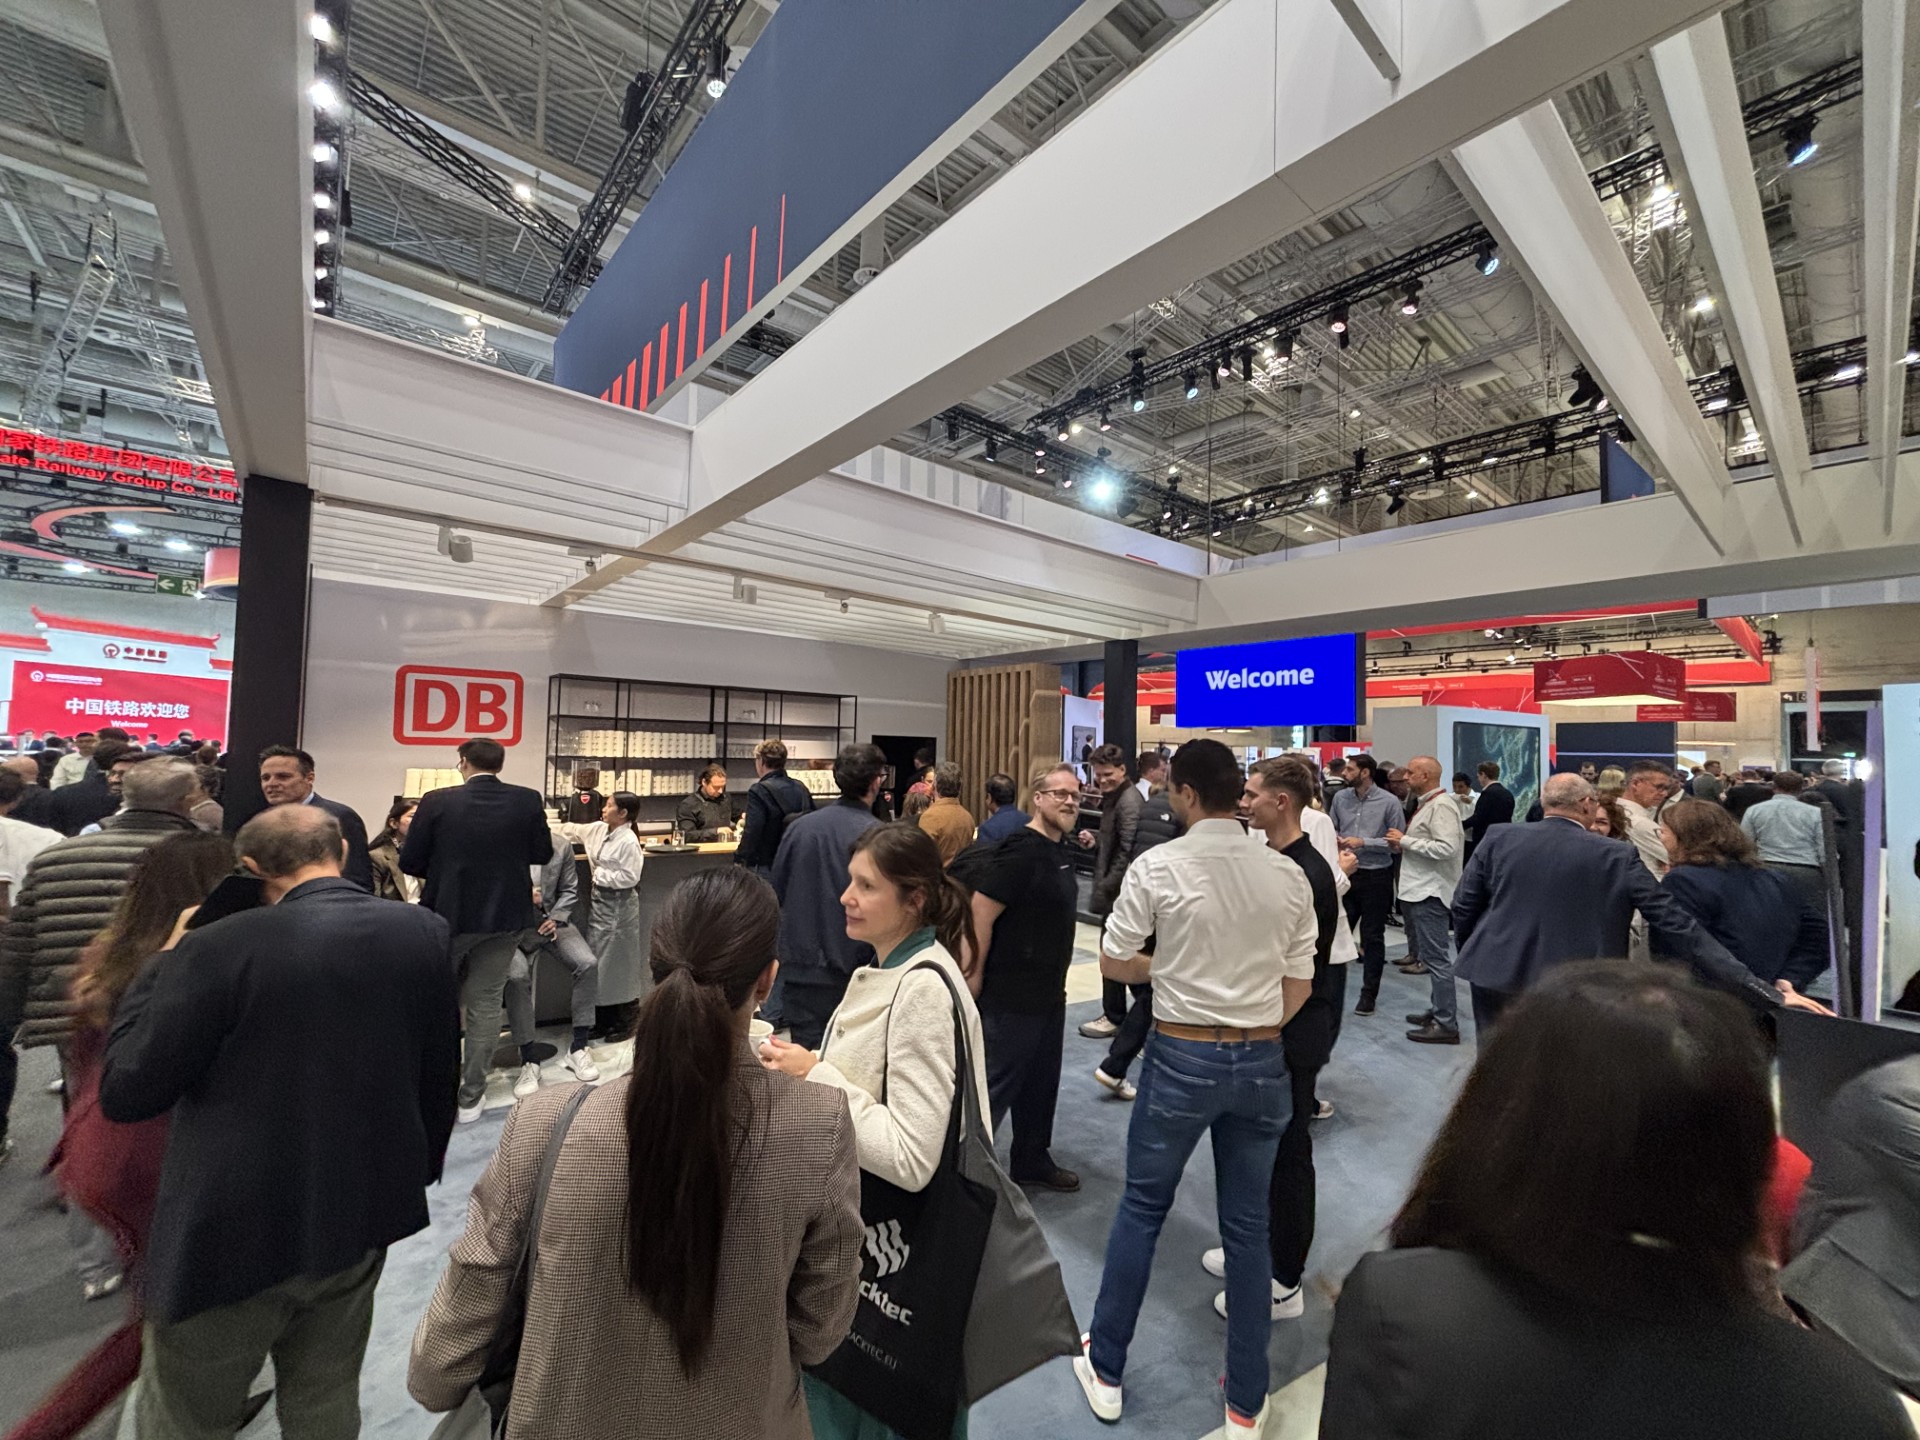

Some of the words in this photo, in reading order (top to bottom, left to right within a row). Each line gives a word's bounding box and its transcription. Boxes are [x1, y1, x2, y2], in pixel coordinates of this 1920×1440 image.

[0, 428, 239, 488] 家铁路集团有限公司
[34, 458, 108, 482] Railway
[112, 470, 167, 491] Group
[1205, 666, 1315, 690] Welcome
[65, 697, 190, 720] 中国铁路欢迎您
[110, 719, 149, 729] Welcome
[412, 678, 508, 734] DB
[858, 1280, 913, 1325] cktec
[850, 1331, 897, 1370] ACKTEC.EU
